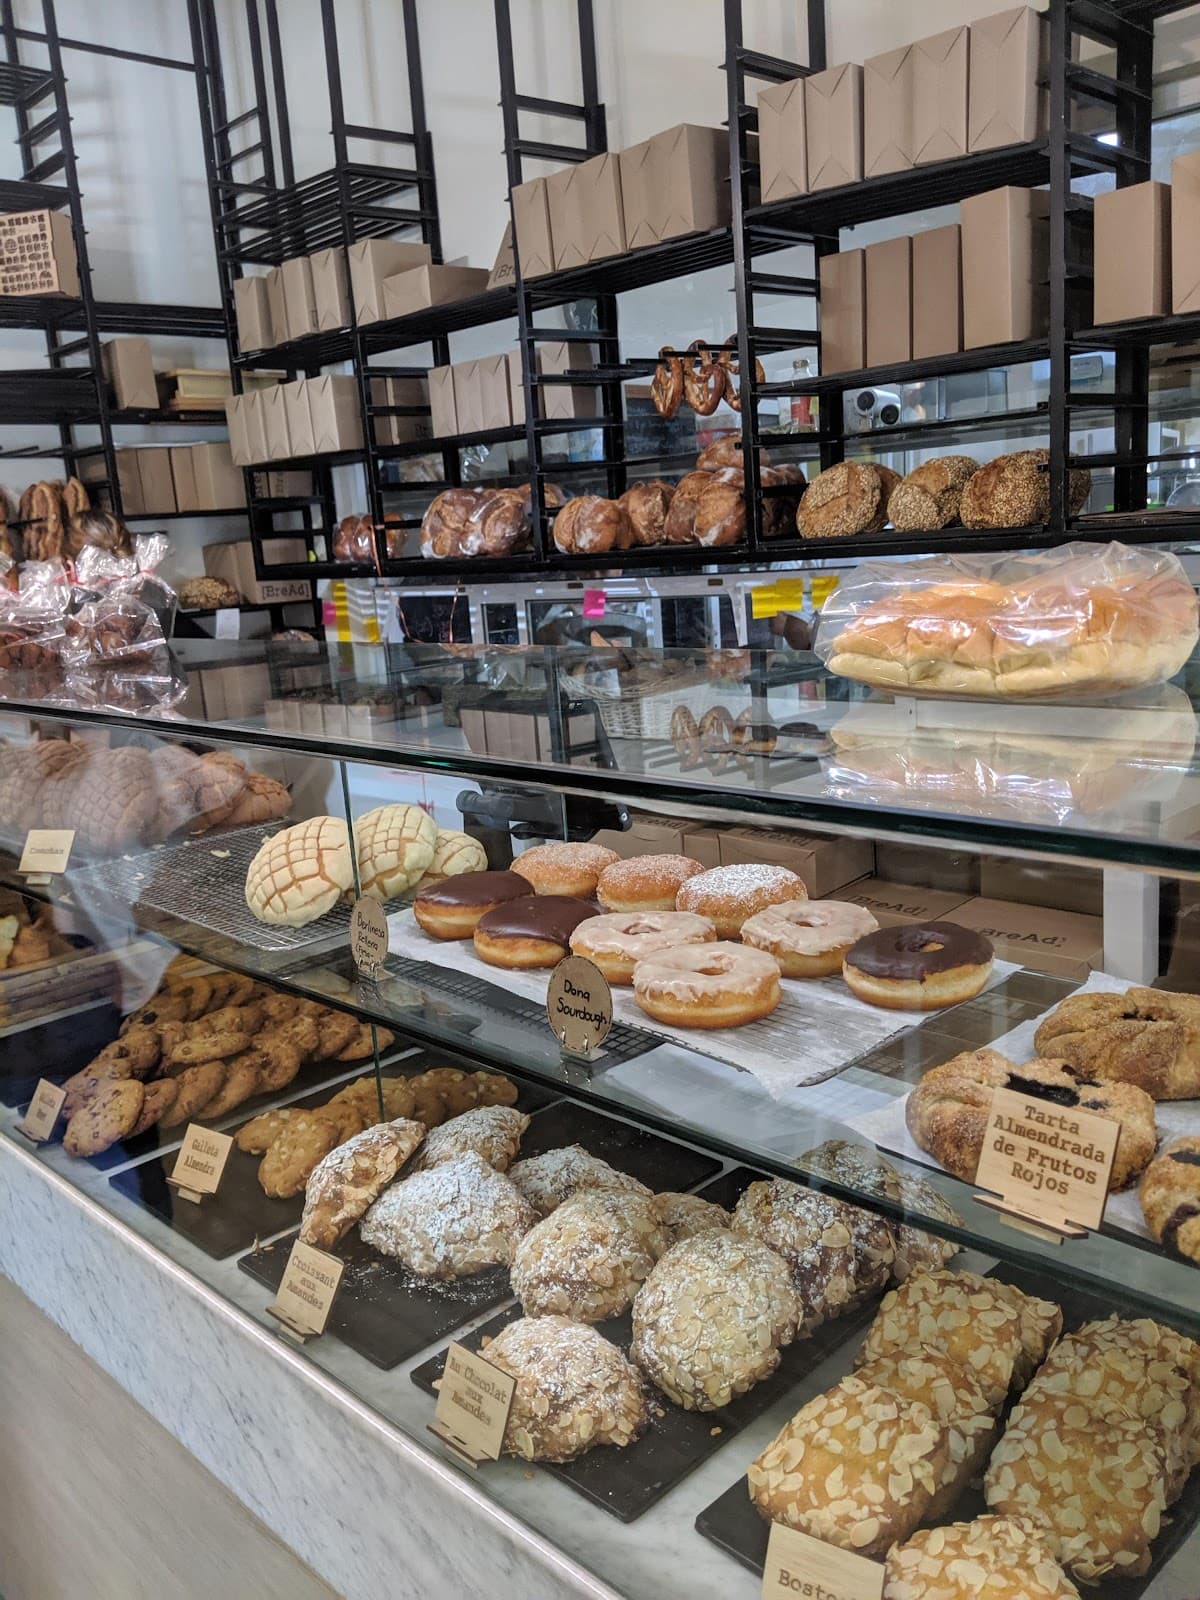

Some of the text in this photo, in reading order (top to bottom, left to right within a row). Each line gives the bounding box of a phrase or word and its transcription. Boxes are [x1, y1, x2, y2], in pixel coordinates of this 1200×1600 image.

[563, 978, 591, 1003] Dona
[556, 997, 608, 1032] Sourdough
[1024, 1104, 1080, 1136] Tarta
[992, 1114, 1106, 1164] Almendrada
[992, 1135, 1098, 1185] de Frutos
[1010, 1161, 1070, 1195] Rojos
[291, 1255, 336, 1289] Croissant
[463, 1365, 508, 1405] Chocolat
